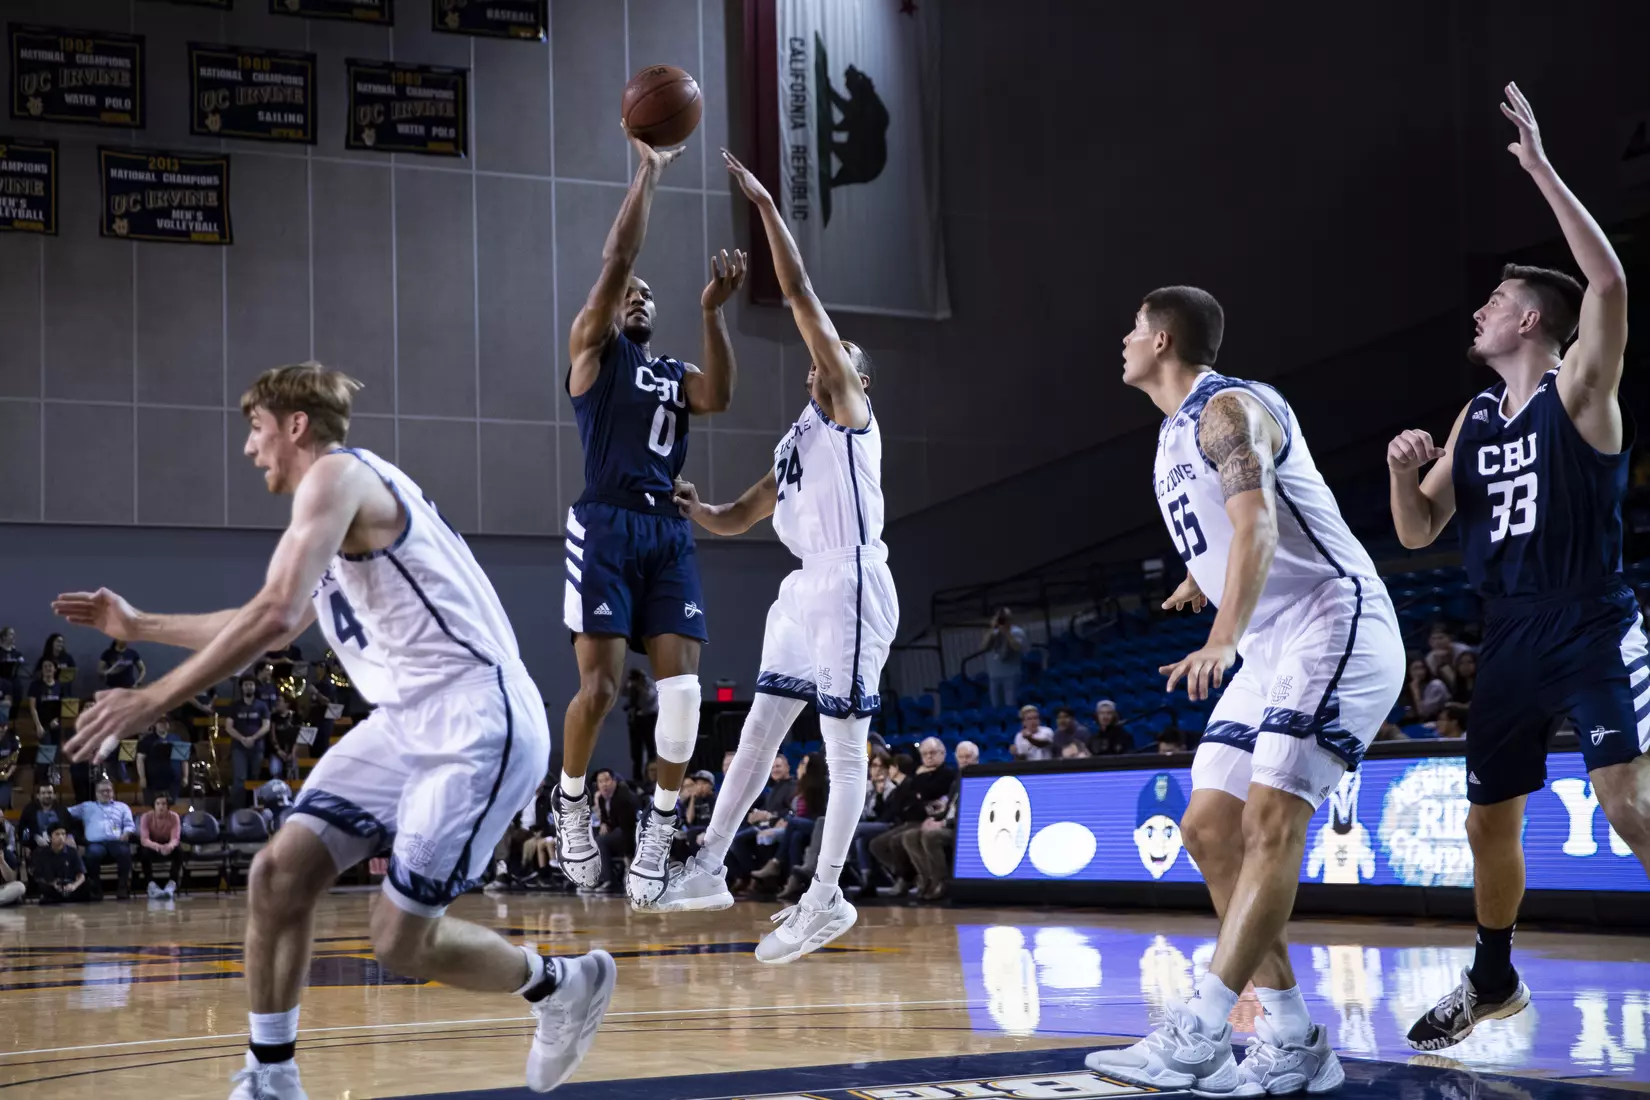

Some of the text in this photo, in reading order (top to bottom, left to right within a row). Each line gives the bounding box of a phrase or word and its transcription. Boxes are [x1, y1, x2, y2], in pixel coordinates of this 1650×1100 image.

[20, 48, 132, 69] NATIONAL CHAMPIONS
[20, 67, 132, 95] UC IRVINE
[199, 66, 305, 87] NATIONAL CHAMPIONS
[64, 92, 132, 112] WATER POLO
[200, 85, 305, 112] UC IRVINE
[356, 81, 456, 101] NATIONAL CHAMPIONS
[257, 110, 305, 125] SAILING
[356, 100, 456, 126] UC IRVINE
[396, 122, 456, 139] WATER POLO
[789, 36, 808, 222] CALIFORNIA REPUBLIC
[110, 167, 220, 187] NATIONAL CHAMPIONS
[148, 156, 180, 172] 2013
[111, 188, 219, 216] UC IRVINE
[156, 217, 219, 233] VOLLEYBALL
[171, 209, 204, 222] MEN'S
[648, 404, 677, 457] 0
[1477, 432, 1538, 476] CBU
[776, 443, 804, 502] 24
[1487, 471, 1538, 544] 33
[1168, 491, 1208, 562] 55
[329, 590, 369, 651] 4
